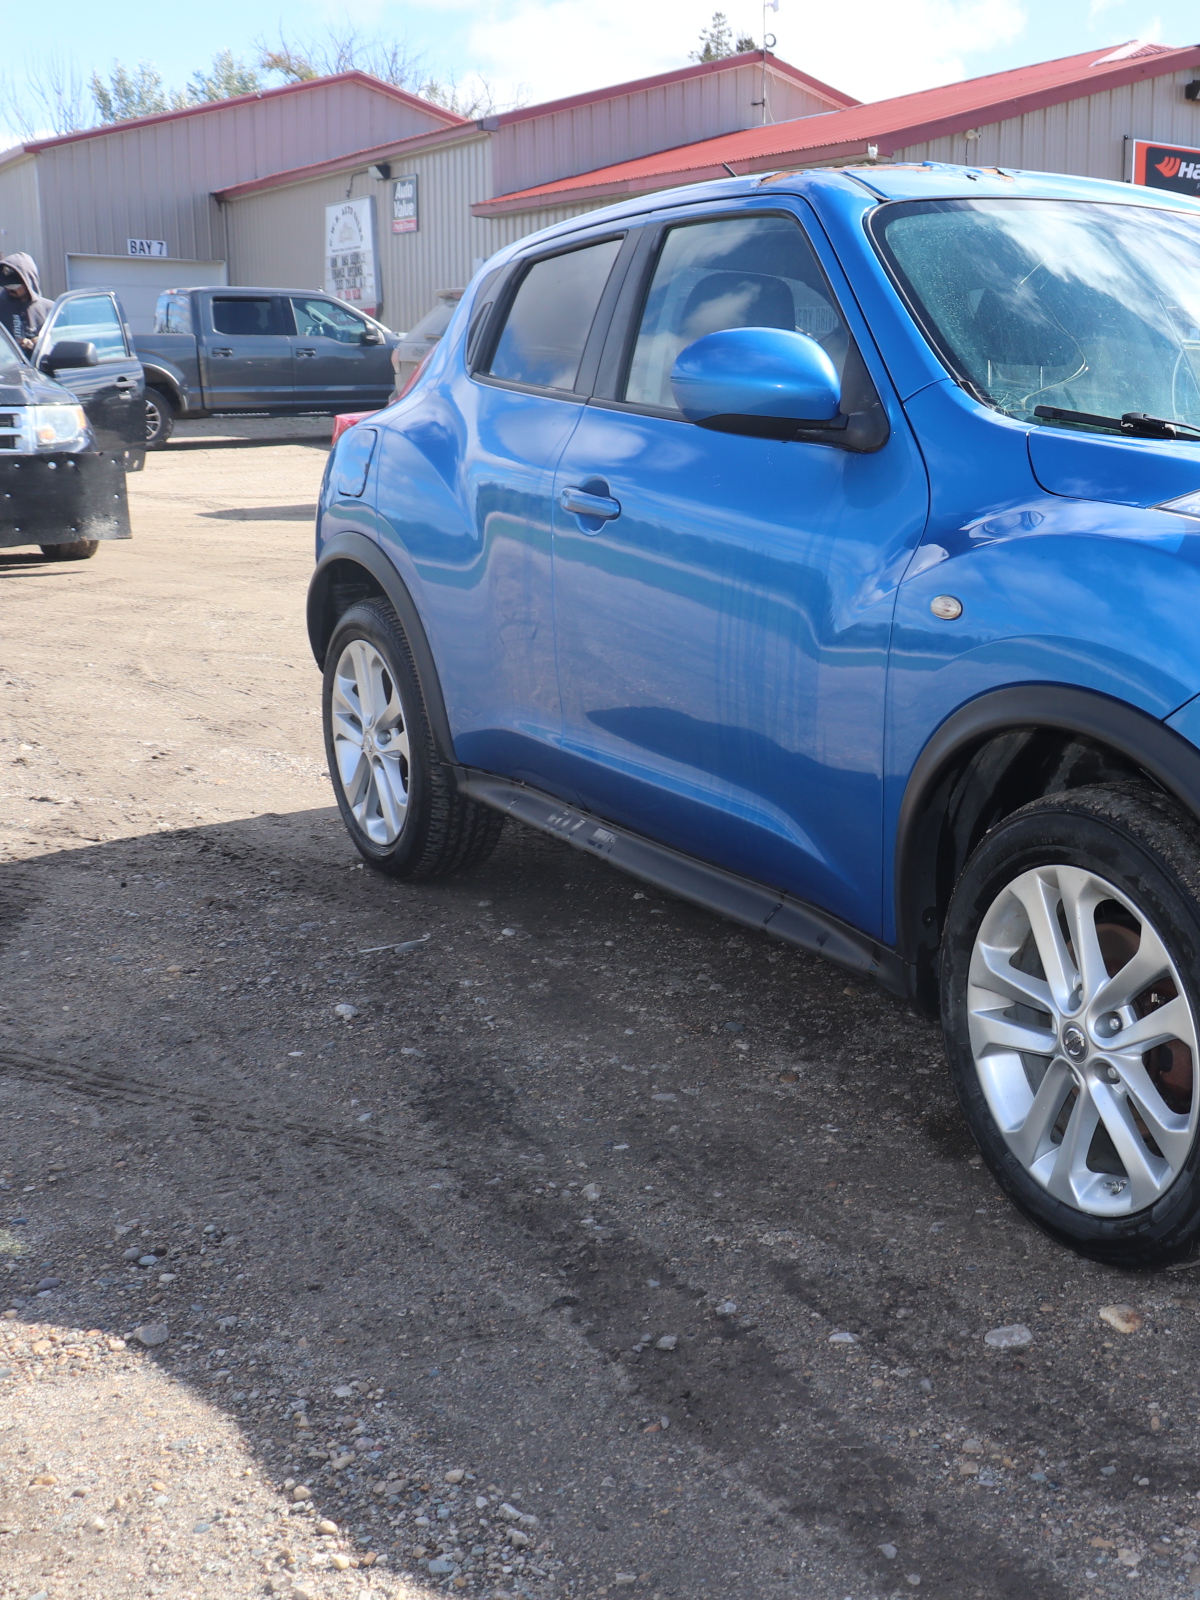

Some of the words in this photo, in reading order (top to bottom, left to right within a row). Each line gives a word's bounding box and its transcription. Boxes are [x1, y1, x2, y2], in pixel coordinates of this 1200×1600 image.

[395, 181, 413, 199] Auto
[393, 200, 414, 218] Value
[130, 240, 152, 255] BAY
[157, 241, 164, 255] 7
